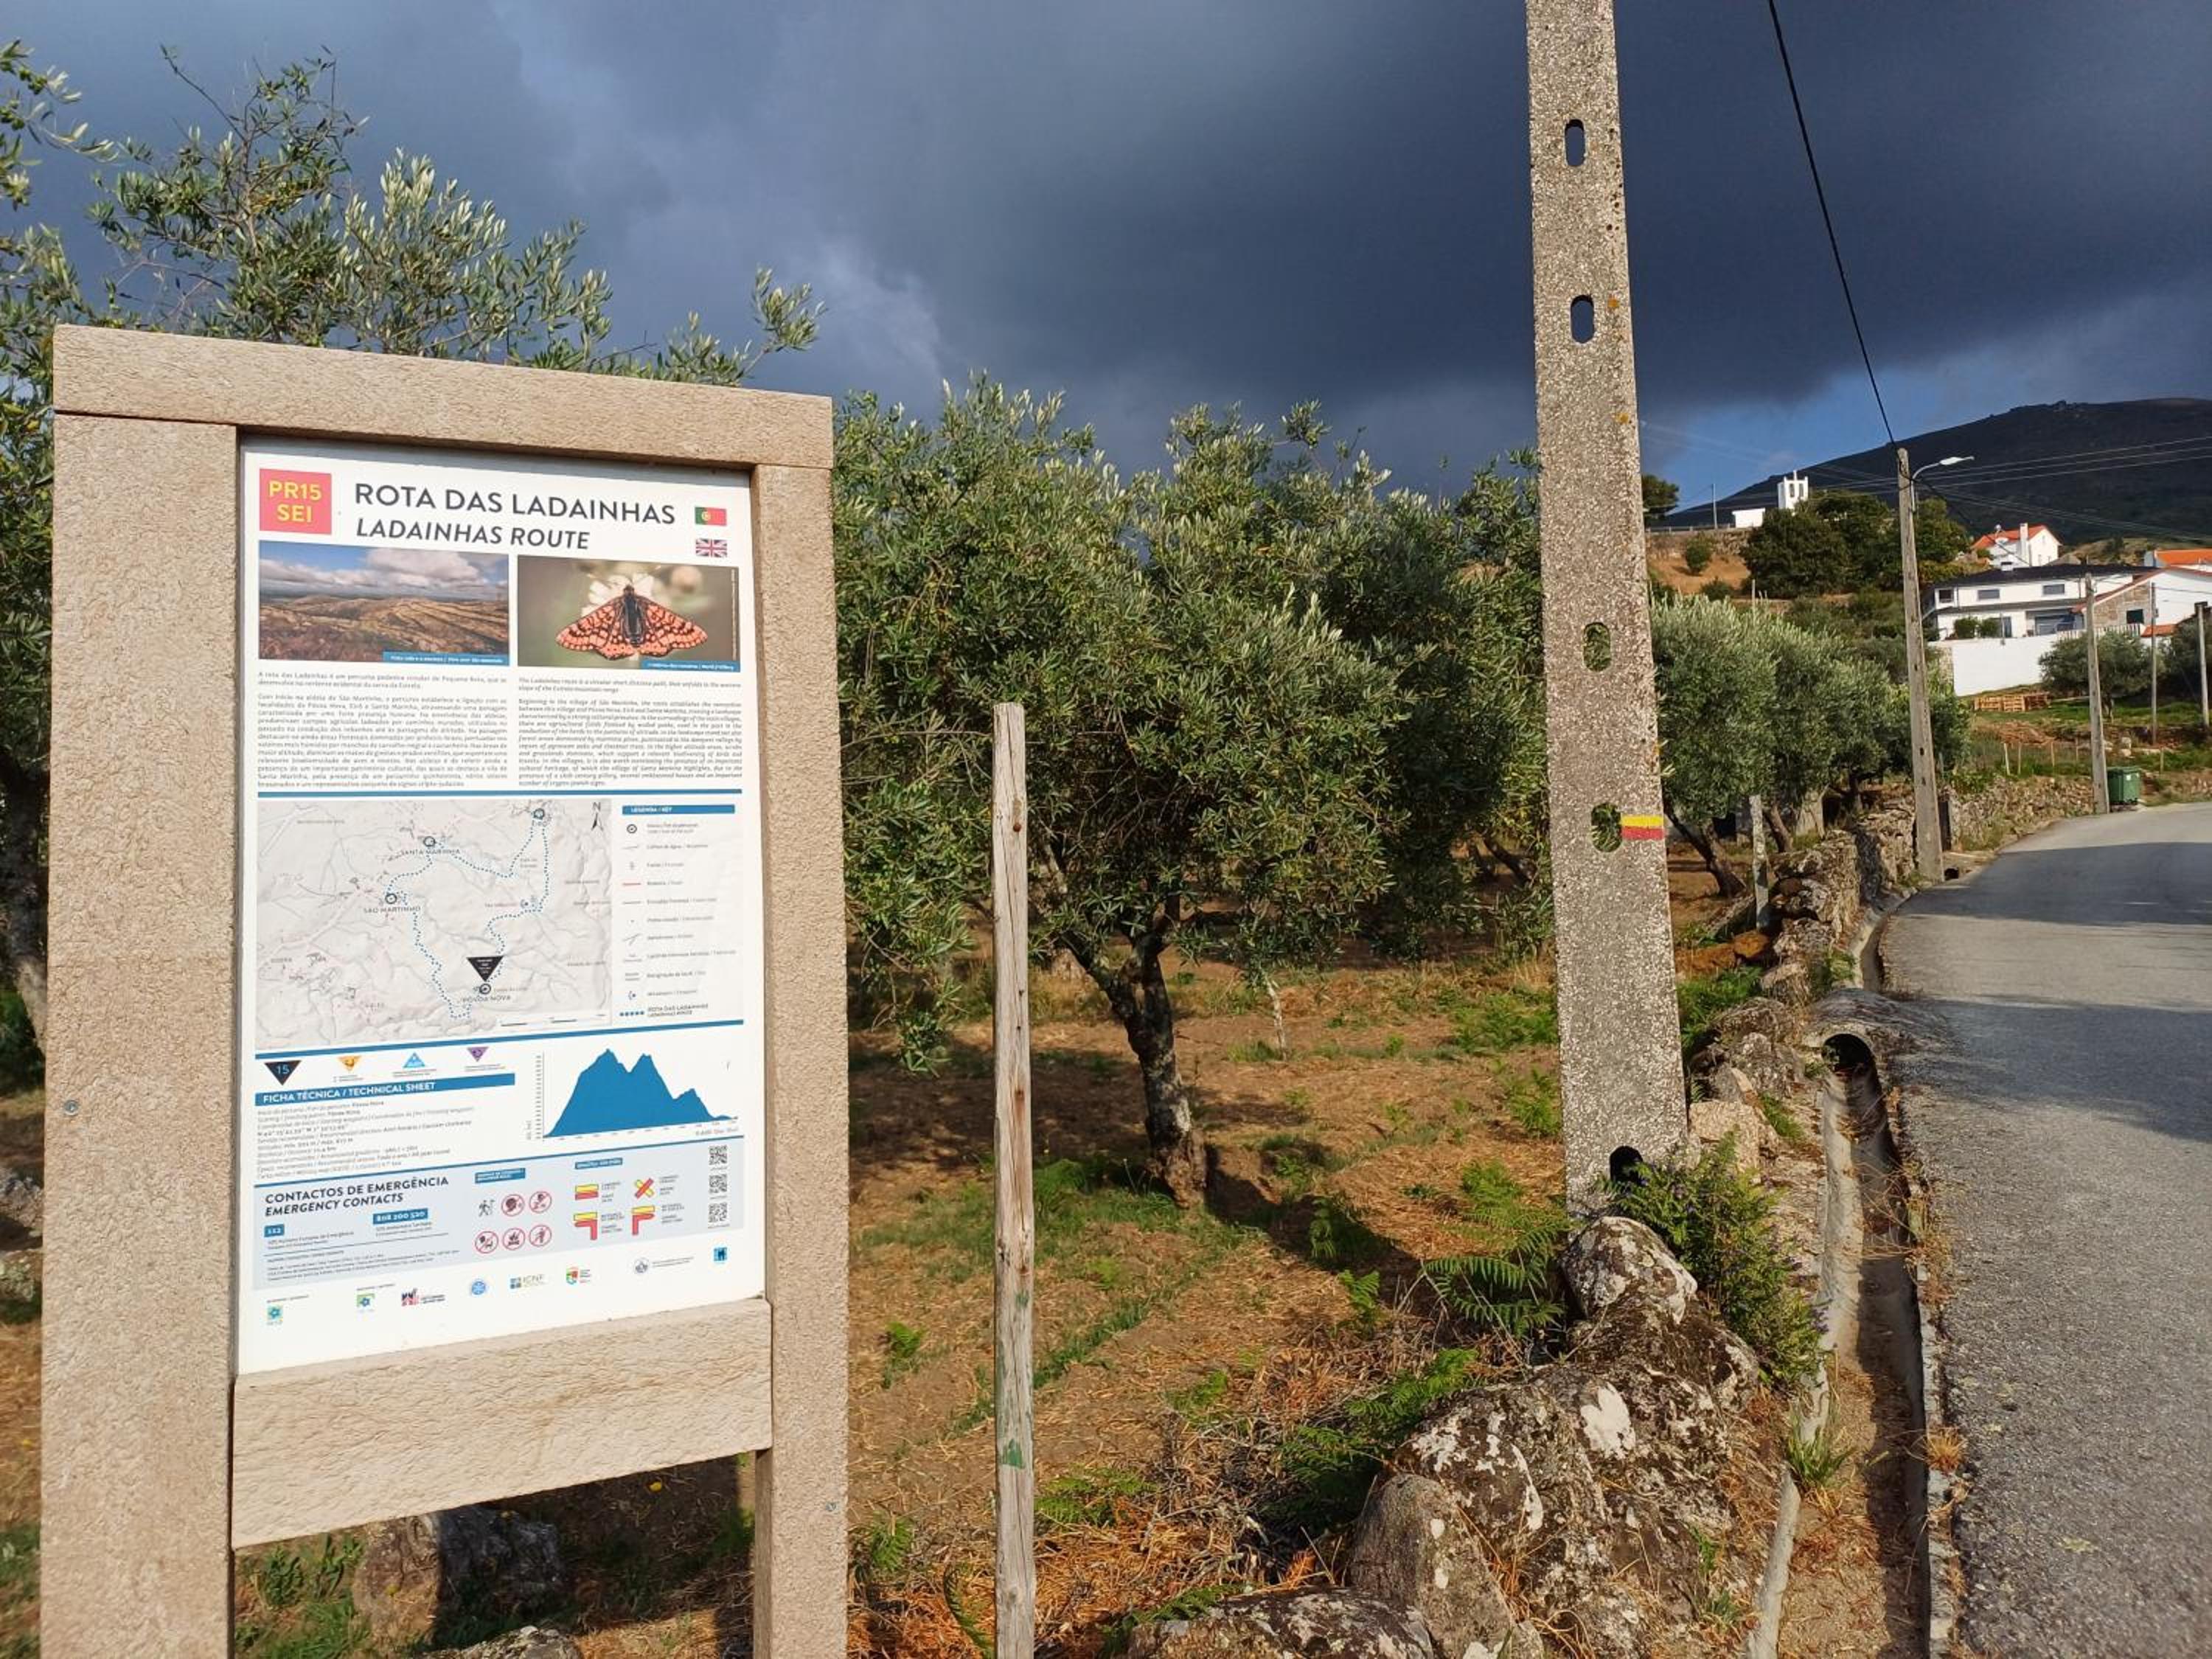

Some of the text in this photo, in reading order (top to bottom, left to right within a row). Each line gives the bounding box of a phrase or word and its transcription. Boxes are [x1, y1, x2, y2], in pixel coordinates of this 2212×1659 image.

[268, 481, 322, 501] PR15
[276, 504, 313, 523] SEI
[354, 483, 675, 525] ROTA DAS LADAINHAS
[356, 518, 591, 550] LADAINHAS ROUTE
[593, 802, 601, 811] N
[276, 1064, 290, 1075] 15
[262, 1091, 295, 1104] FICHA
[299, 1088, 342, 1102] TÉCNICA
[349, 1083, 405, 1096] TECHNICAL
[406, 1082, 437, 1093] SHEET
[265, 1176, 449, 1205] CONTACTOS DE EMERGÊNCIA
[265, 1193, 404, 1217] EMERGENCY CONTACTS
[393, 1212, 409, 1221] 200
